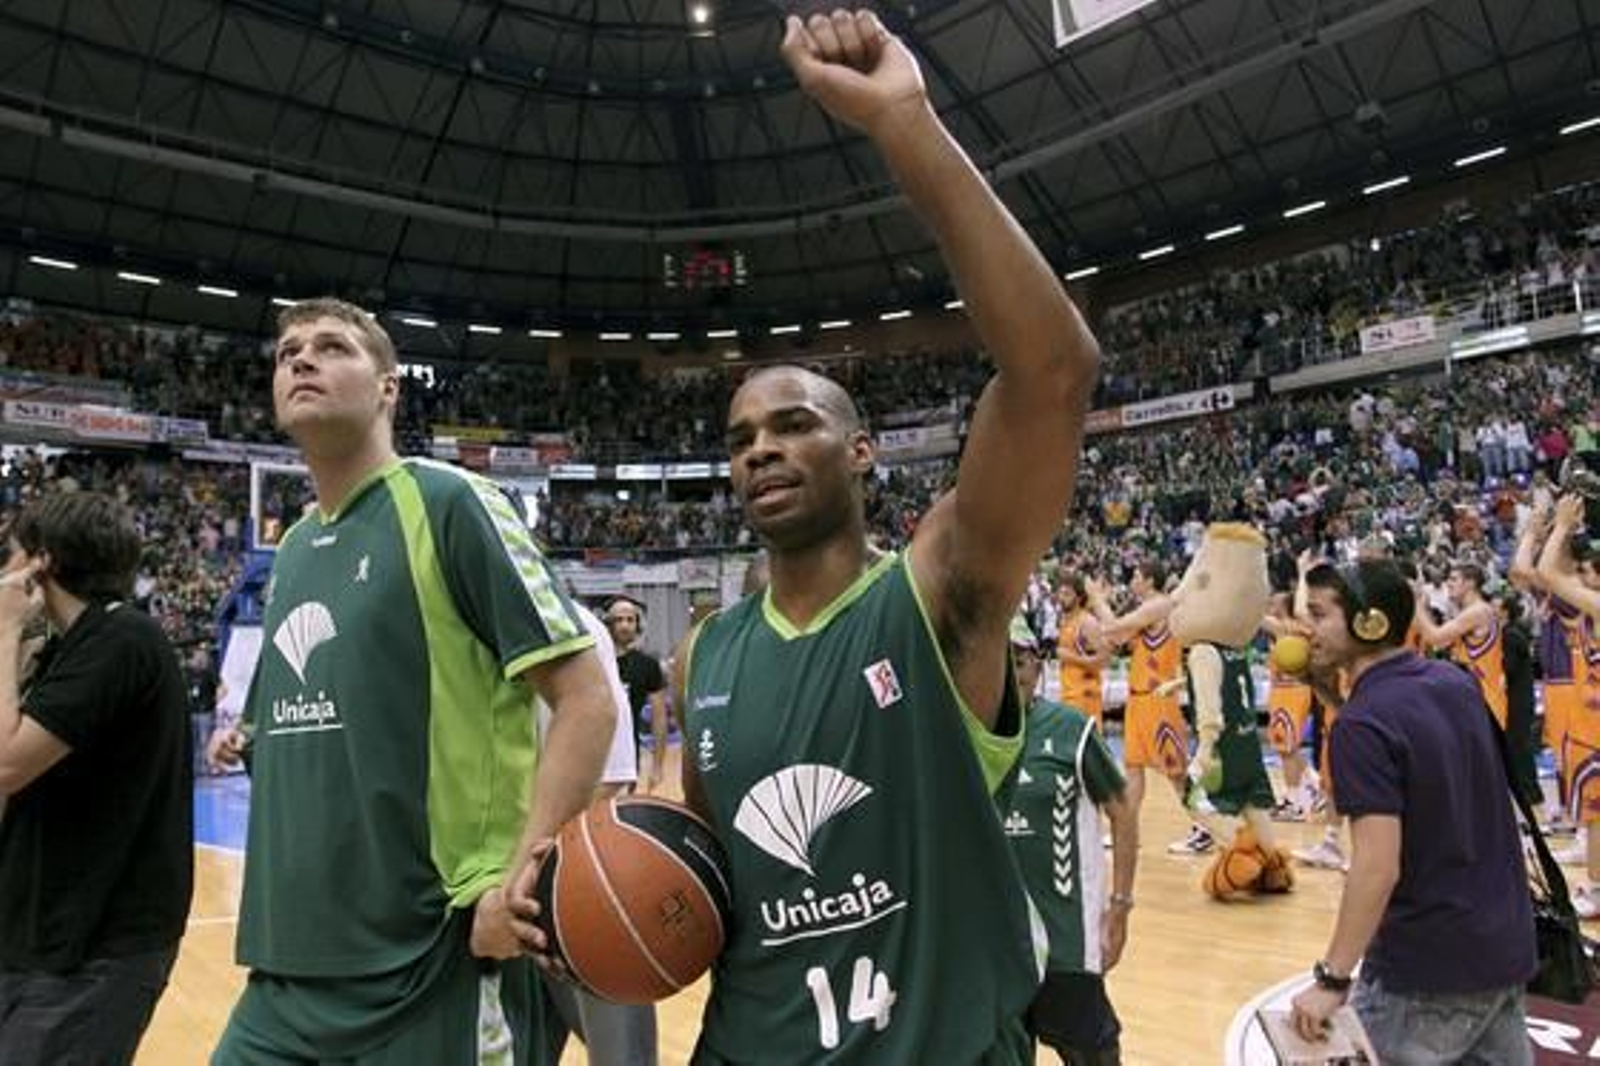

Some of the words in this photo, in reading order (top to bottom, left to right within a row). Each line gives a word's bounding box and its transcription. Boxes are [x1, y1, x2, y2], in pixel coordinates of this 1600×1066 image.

[272, 689, 337, 729] Unicaja
[760, 872, 893, 932] Unicaja
[806, 955, 897, 1049] 14
